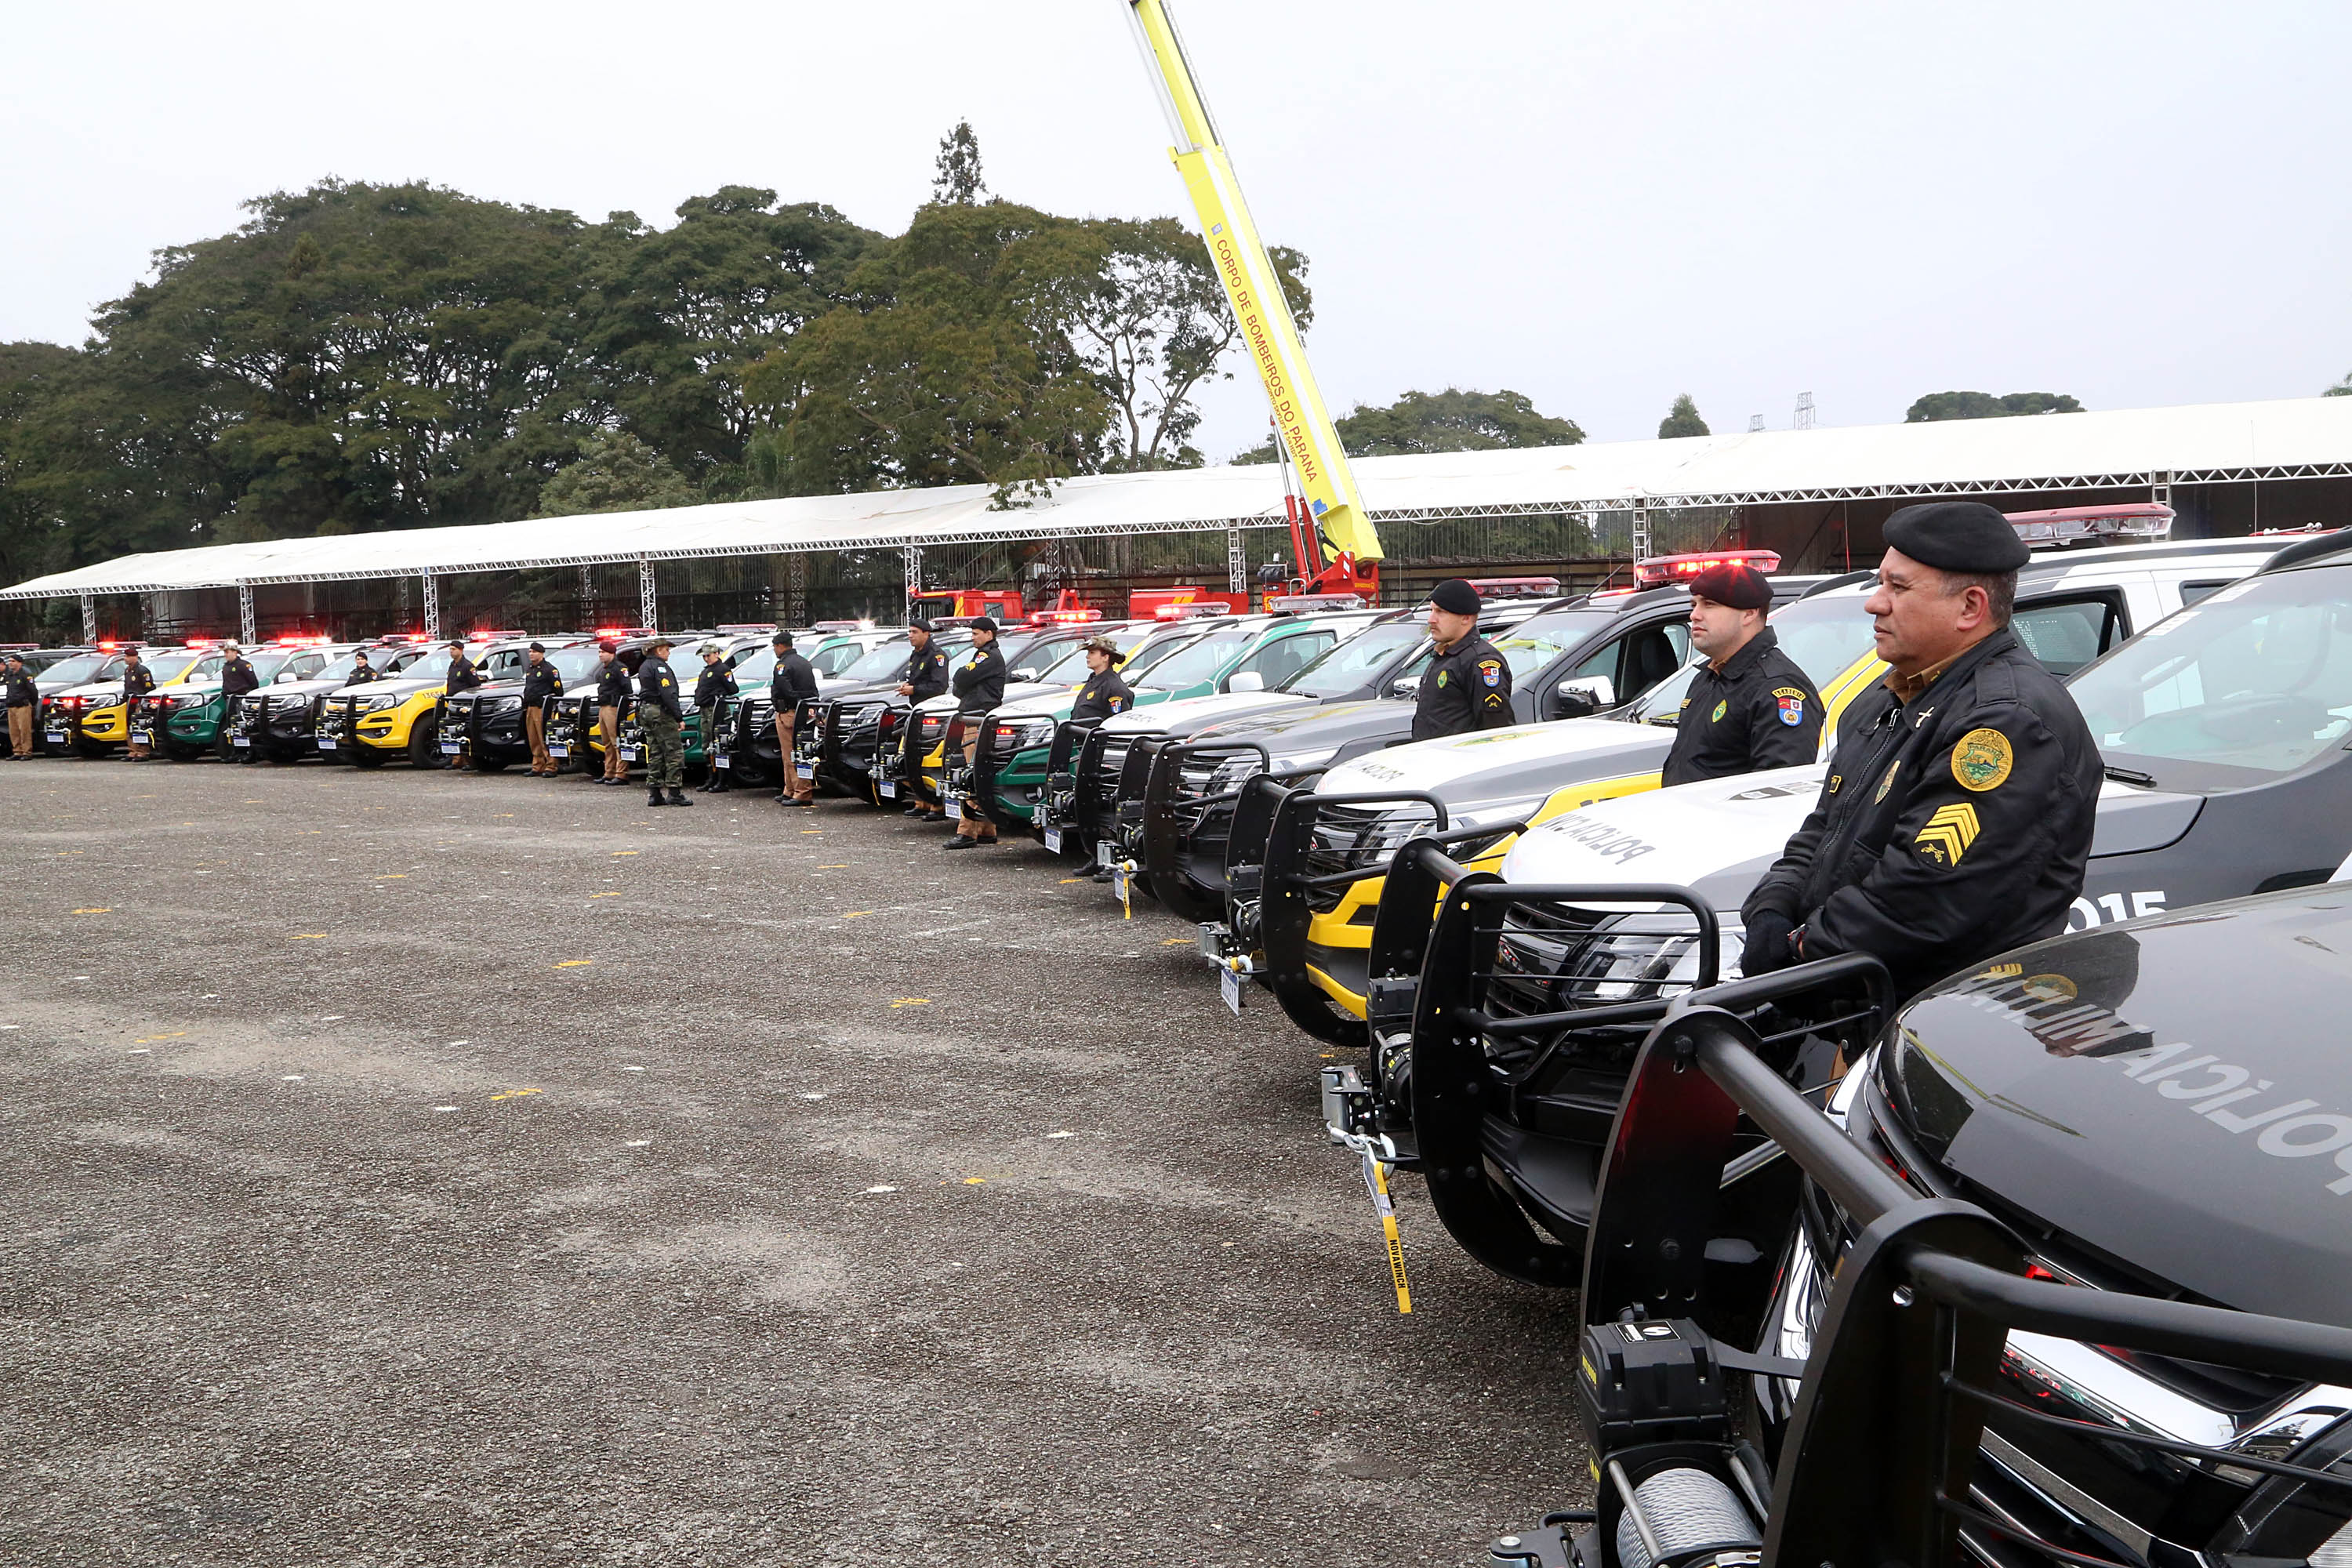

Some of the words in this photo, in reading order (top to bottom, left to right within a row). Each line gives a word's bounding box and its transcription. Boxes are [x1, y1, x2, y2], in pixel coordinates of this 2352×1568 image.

[1217, 239, 1242, 289] CORPO
[1237, 290, 1251, 312] DE
[1247, 314, 1285, 397] BOMBEIROS
[1279, 401, 1294, 423] DO
[1289, 426, 1318, 483] PARANA
[1389, 1240, 1406, 1288] NOVAWINCH
